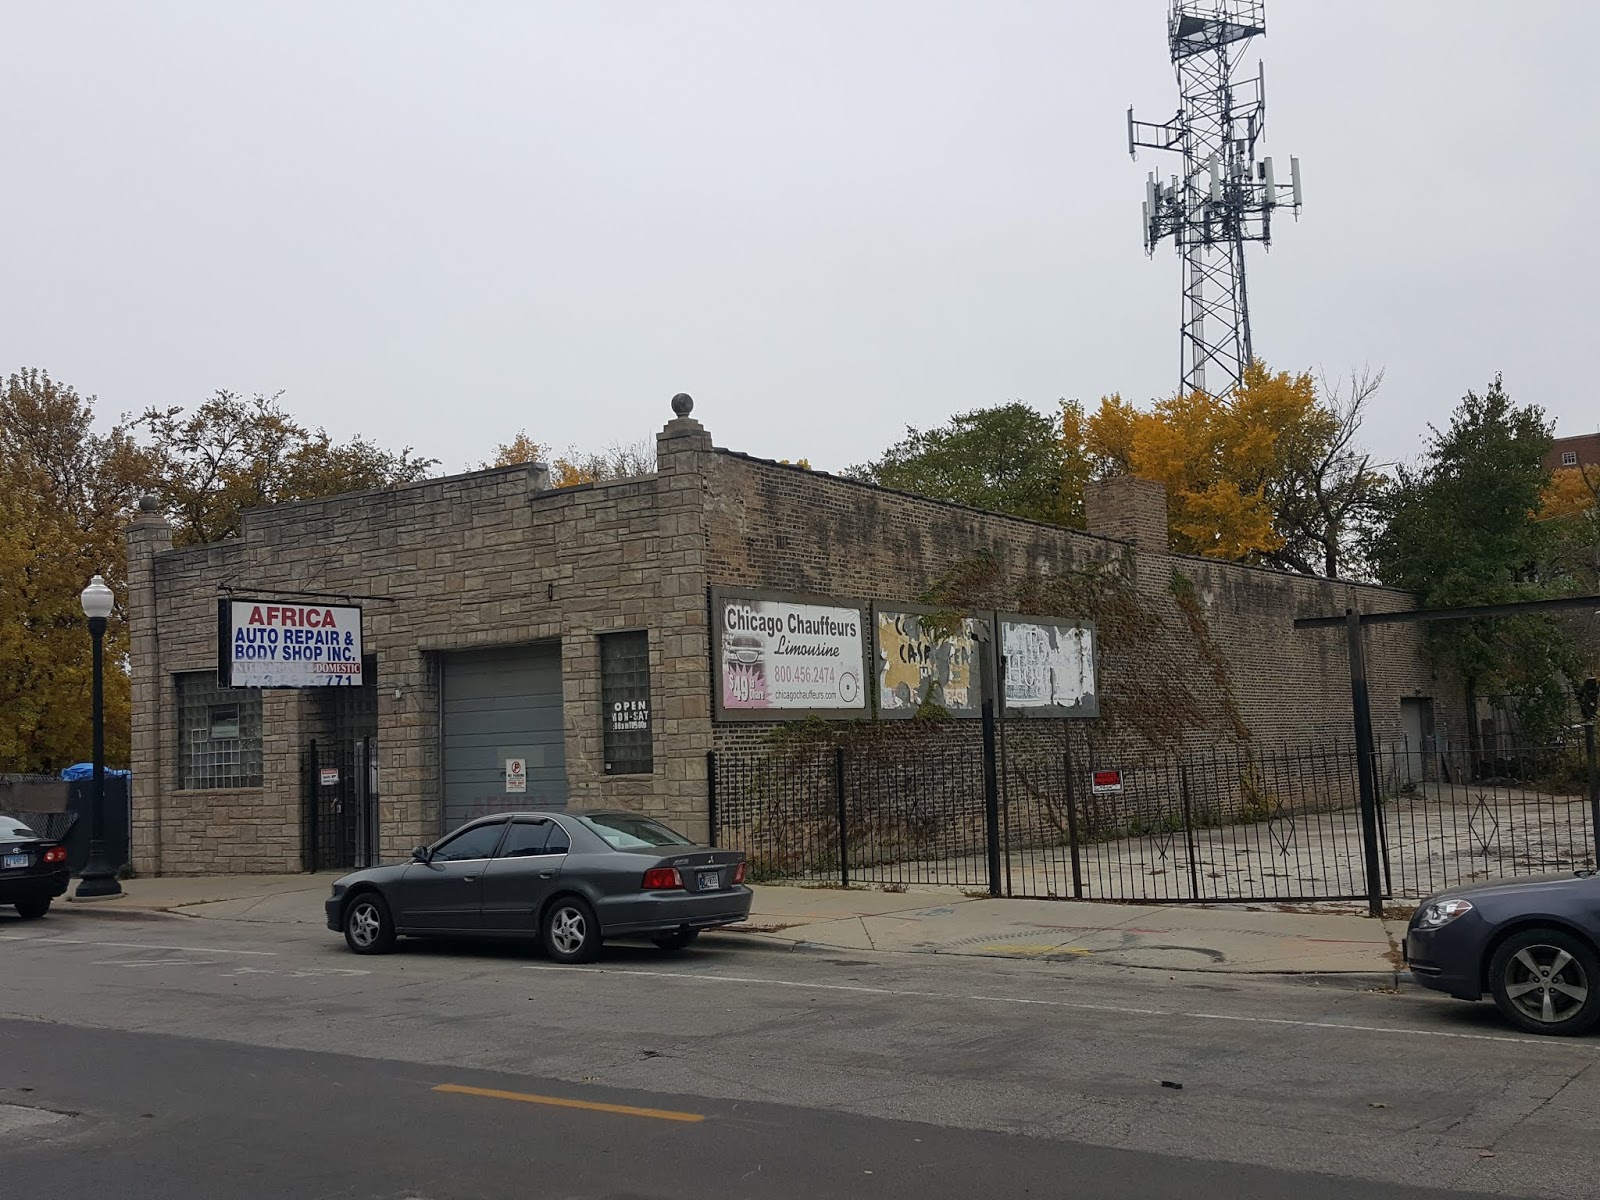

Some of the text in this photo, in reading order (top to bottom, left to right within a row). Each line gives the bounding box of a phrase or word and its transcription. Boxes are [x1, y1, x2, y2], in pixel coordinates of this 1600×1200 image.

[249, 606, 336, 628] AFRICA
[727, 608, 856, 637] Chicago Chauffeurs
[235, 627, 354, 646] AUTO REPAIR &
[235, 644, 356, 661] BODY SHOP INC.
[774, 635, 840, 657] Limousine
[316, 663, 360, 674] DOMESTIC
[775, 665, 835, 683] 800.456.2474
[775, 689, 837, 702] chicagochauffeurs.com
[614, 700, 646, 711] OPEN
